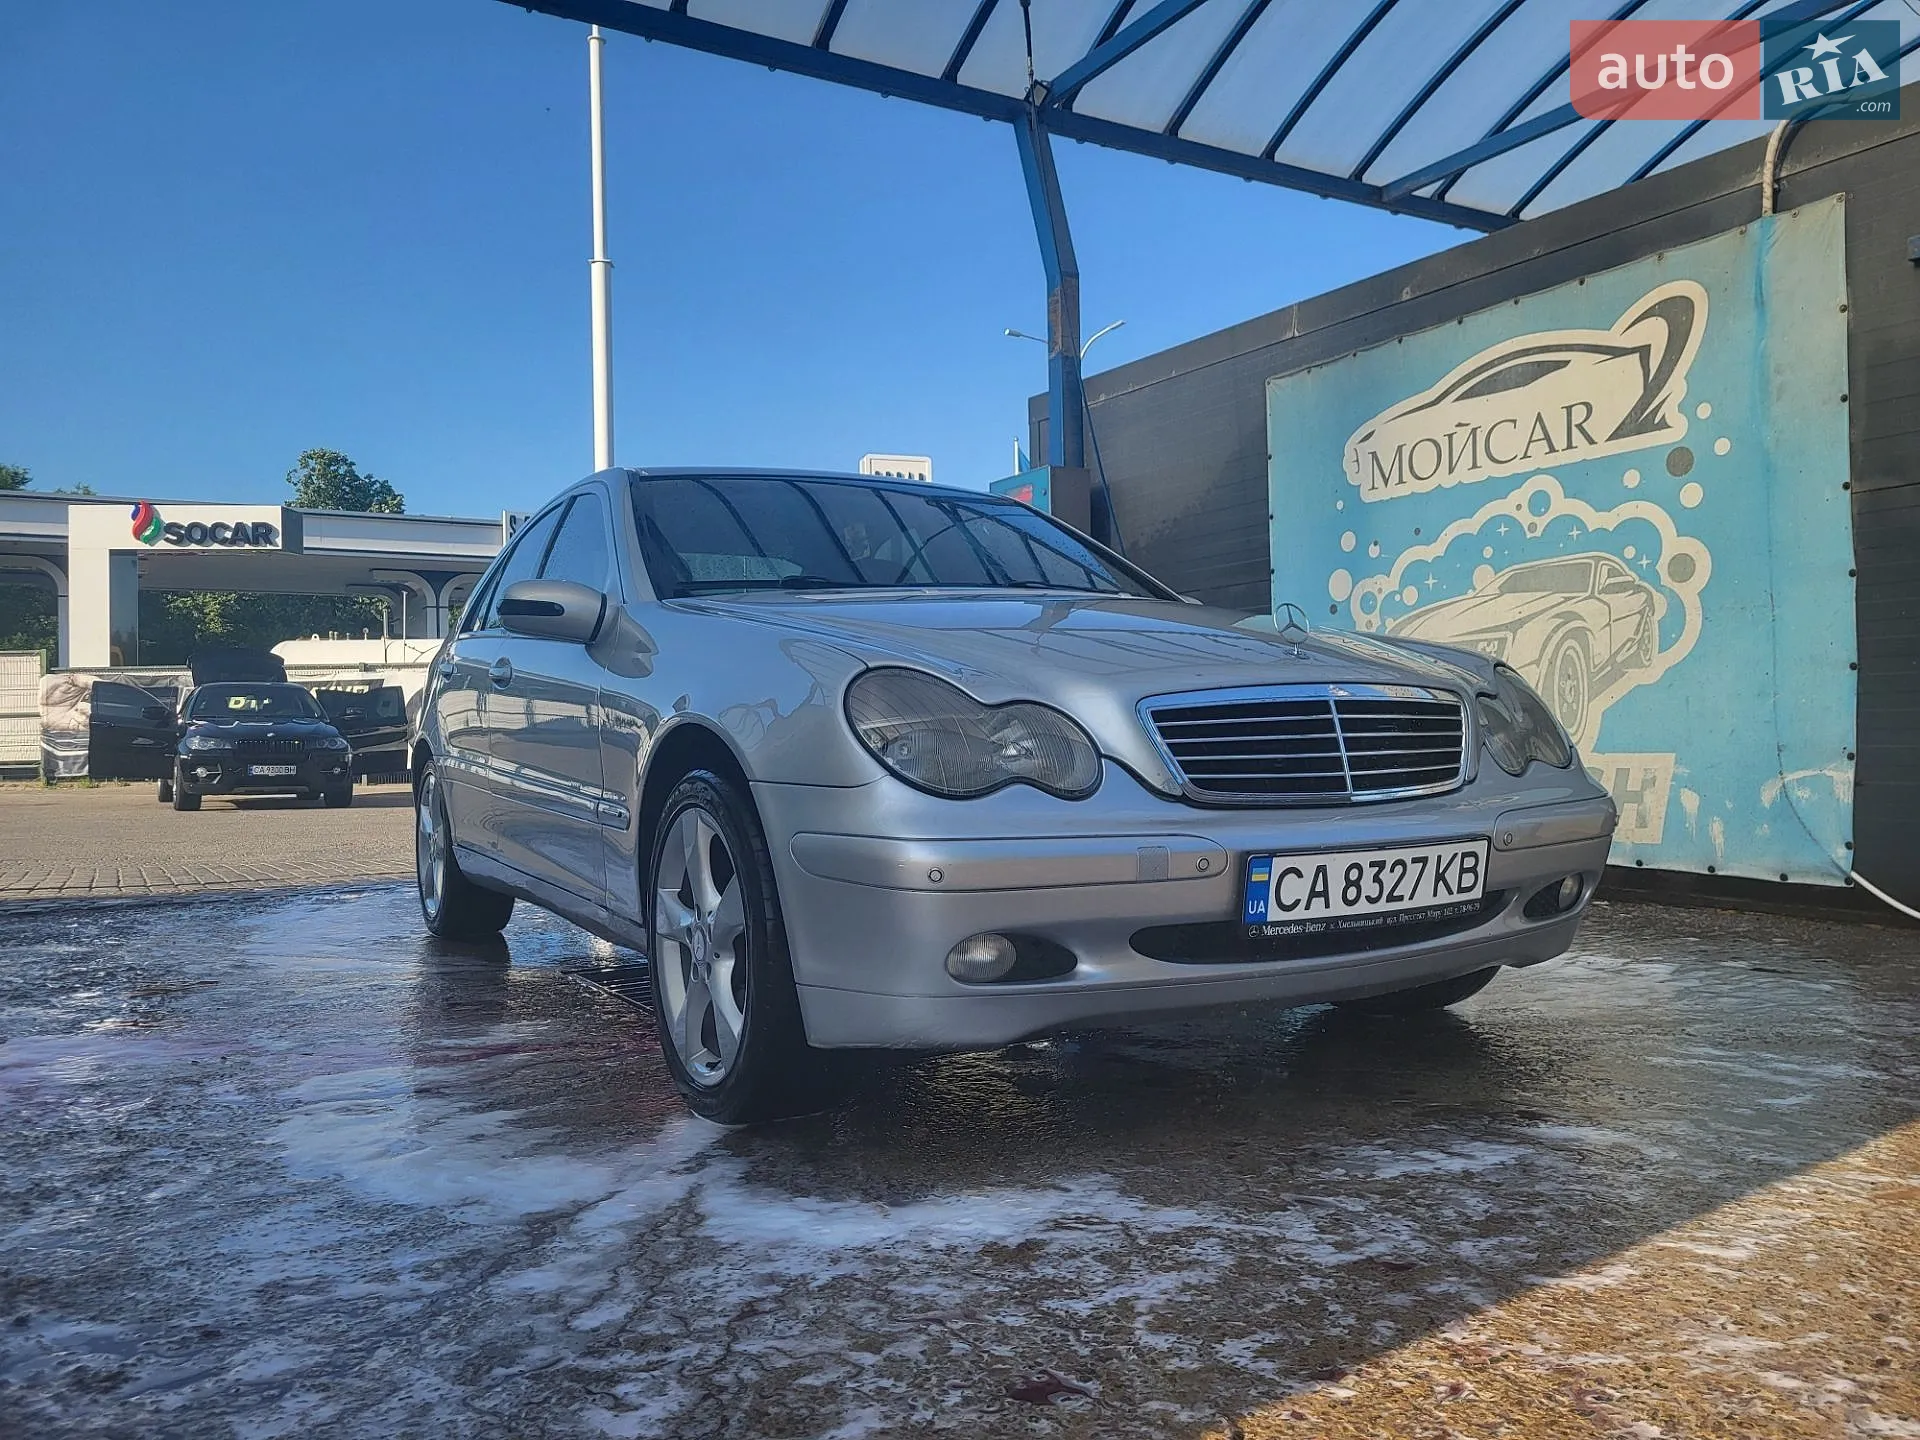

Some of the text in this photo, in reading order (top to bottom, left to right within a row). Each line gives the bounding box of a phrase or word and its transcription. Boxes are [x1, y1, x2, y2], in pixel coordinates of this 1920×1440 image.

[163, 521, 277, 547] SOCAR
[1274, 850, 1480, 912] CA 8327 KB
[1248, 900, 1266, 914] UA
[1262, 921, 1327, 937] Mercedes-Benz
